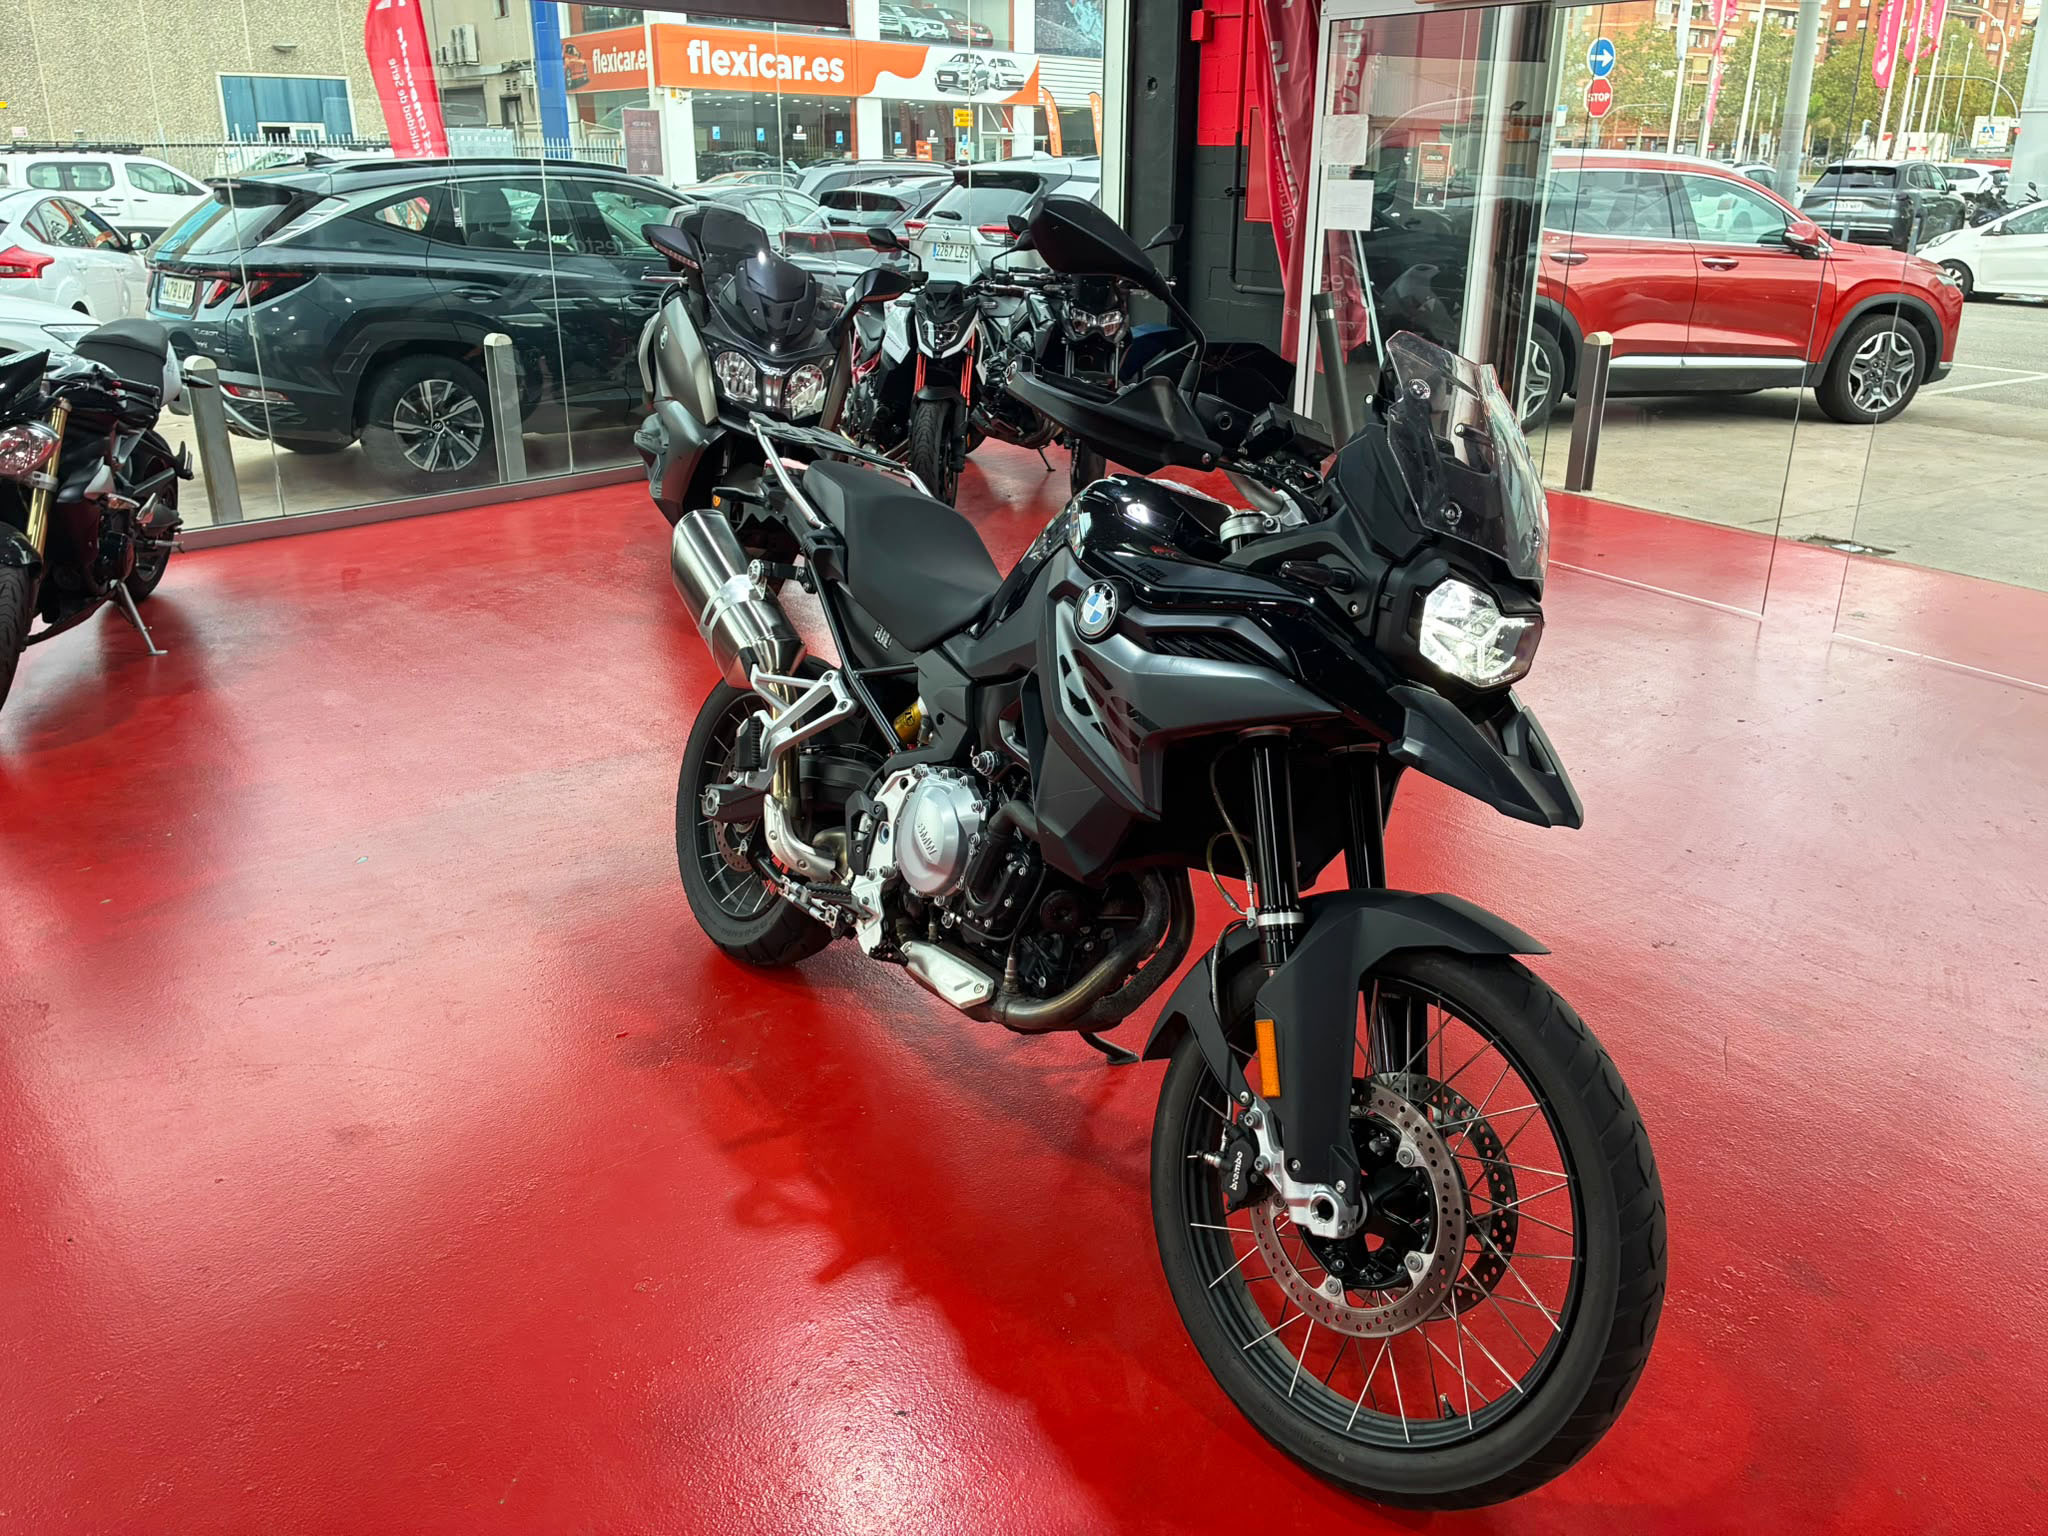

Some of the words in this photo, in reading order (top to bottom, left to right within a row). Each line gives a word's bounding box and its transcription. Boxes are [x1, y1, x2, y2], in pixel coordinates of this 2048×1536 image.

[687, 39, 845, 83] flexicar.es
[1587, 92, 1610, 102] STOP
[936, 244, 954, 257] 2267
[955, 245, 969, 258] LZS
[178, 282, 193, 301] LVG
[1229, 1151, 1243, 1191] brembo
